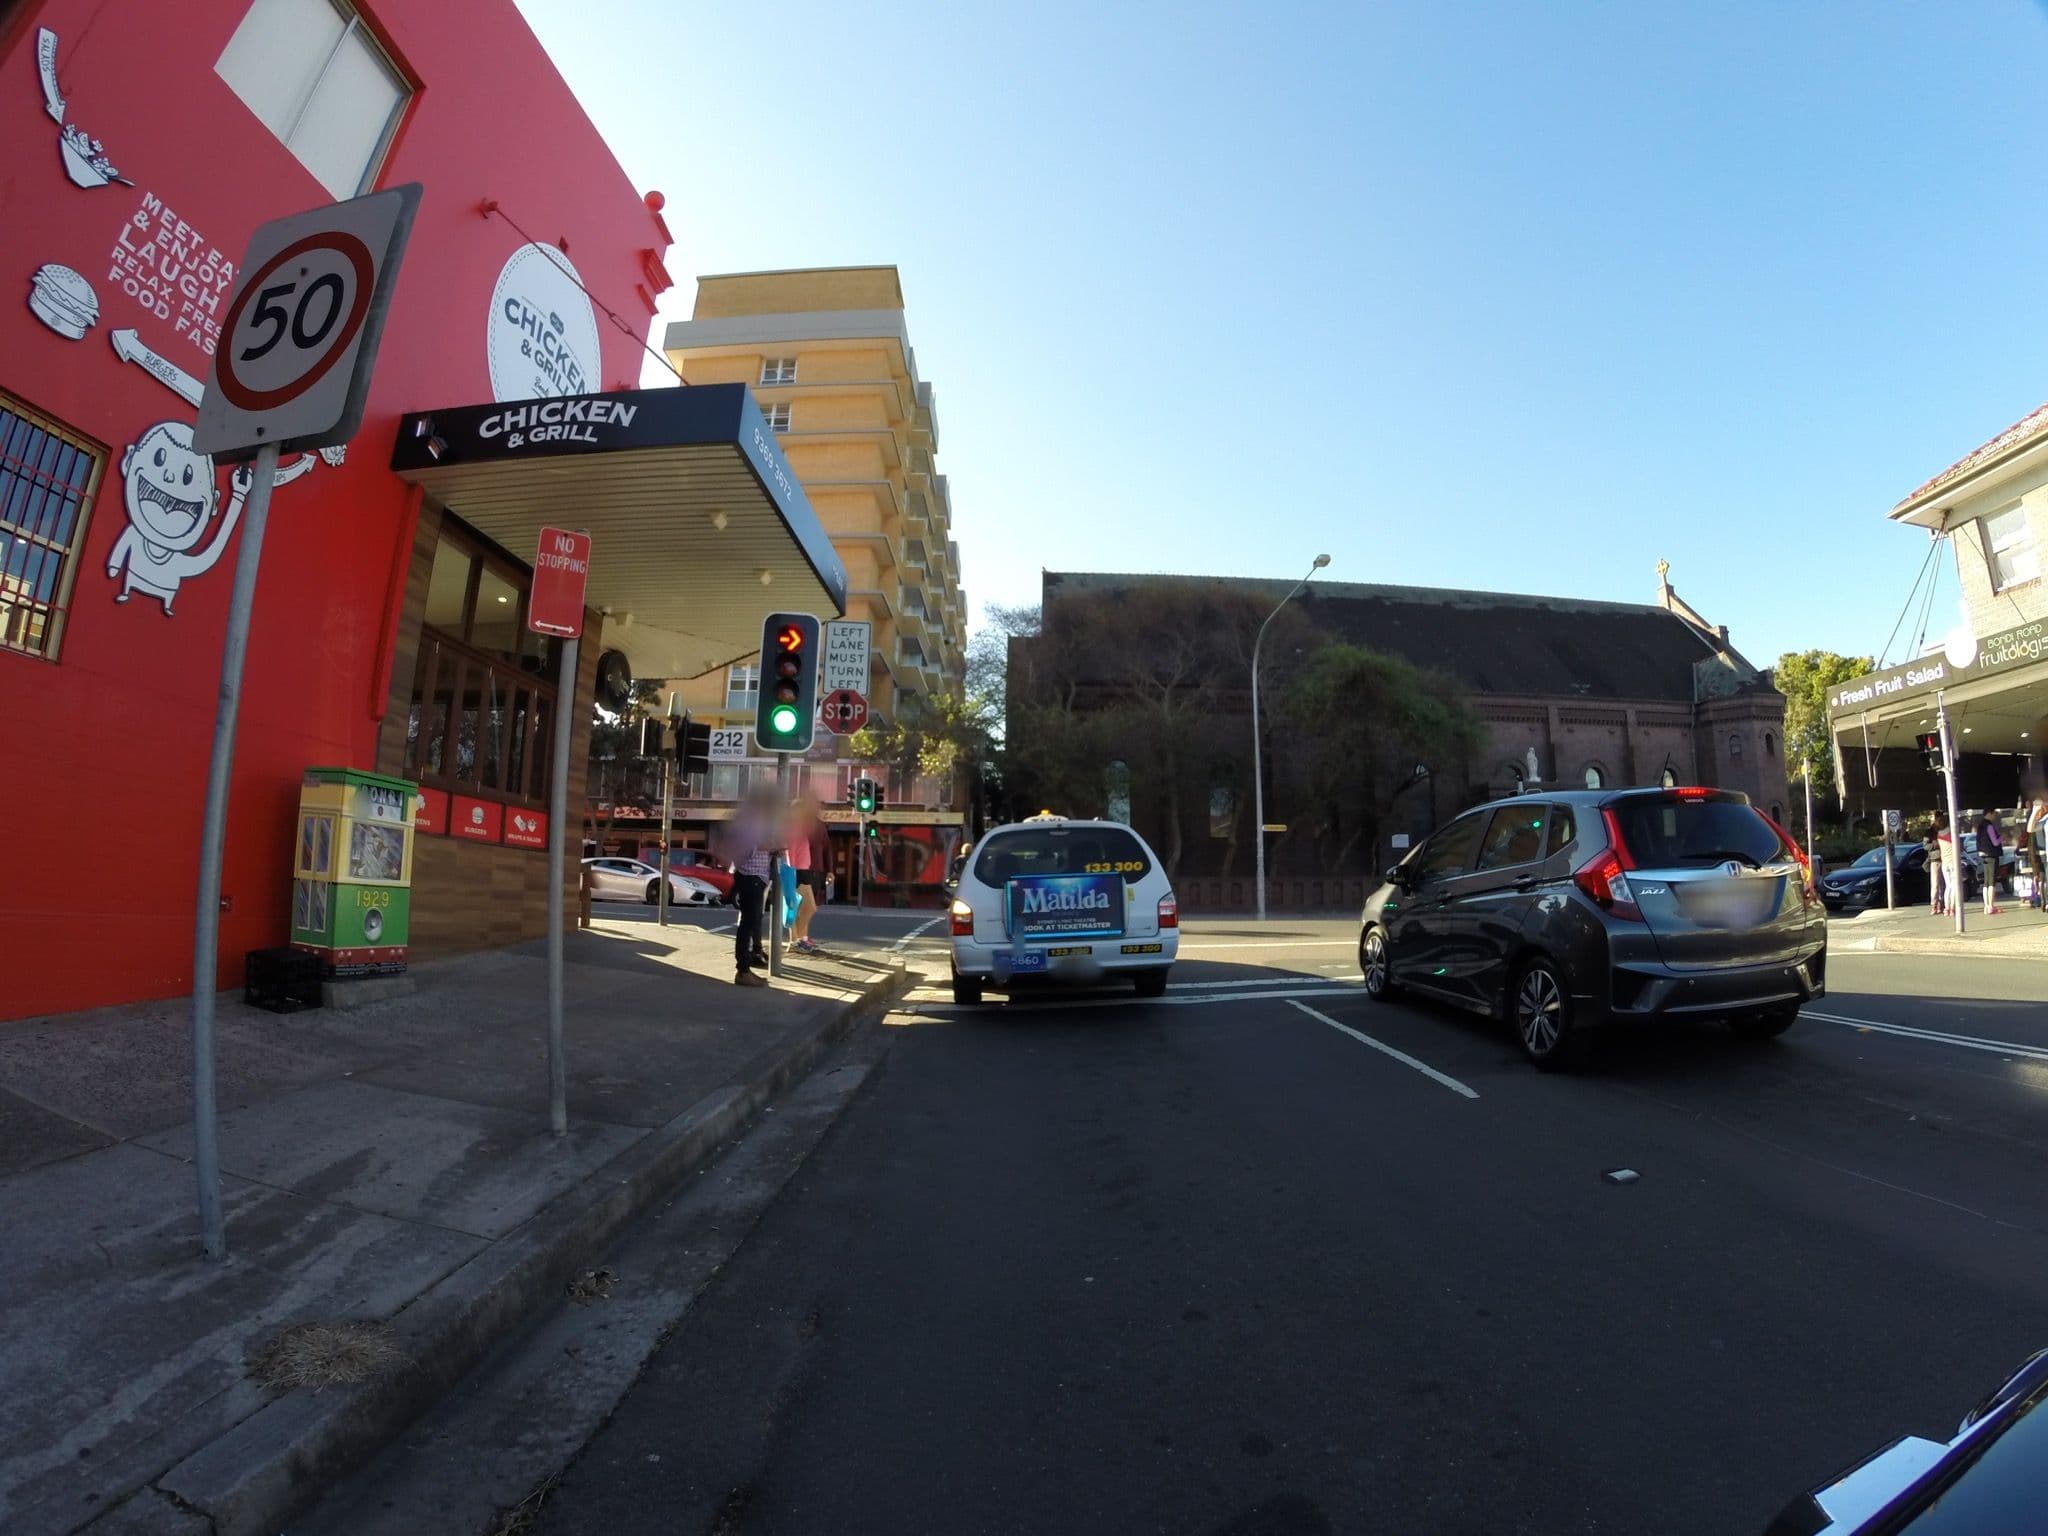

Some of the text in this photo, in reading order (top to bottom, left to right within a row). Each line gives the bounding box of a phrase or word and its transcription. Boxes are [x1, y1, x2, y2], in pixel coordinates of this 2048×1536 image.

[133, 210, 229, 294] & ENJOY
[118, 223, 219, 316] LAUGH
[207, 248, 240, 281] EA
[108, 265, 217, 355] FOOD FAS
[182, 301, 222, 339] FRES
[240, 273, 344, 361] 50
[521, 339, 532, 358] &
[144, 351, 179, 382] BURGERS
[479, 400, 638, 438] CHICKEN
[507, 425, 598, 448] & GRILL
[555, 535, 575, 553] NO
[539, 553, 586, 574] STOPPING
[833, 627, 864, 637] LEFT
[1987, 624, 2042, 649] BONDI ROAD
[831, 640, 864, 650] LANE
[829, 653, 864, 663] MUST
[829, 666, 863, 676] TURN
[830, 680, 861, 689] LEFT
[1840, 662, 1944, 706] Fresh Fruit Salad
[713, 732, 743, 747] 212
[674, 809, 687, 817] RD
[1085, 861, 1143, 872] 133 300
[356, 889, 389, 908] 1929
[1022, 885, 1110, 913] Matilda
[1058, 922, 1111, 930] TICKETMASTER
